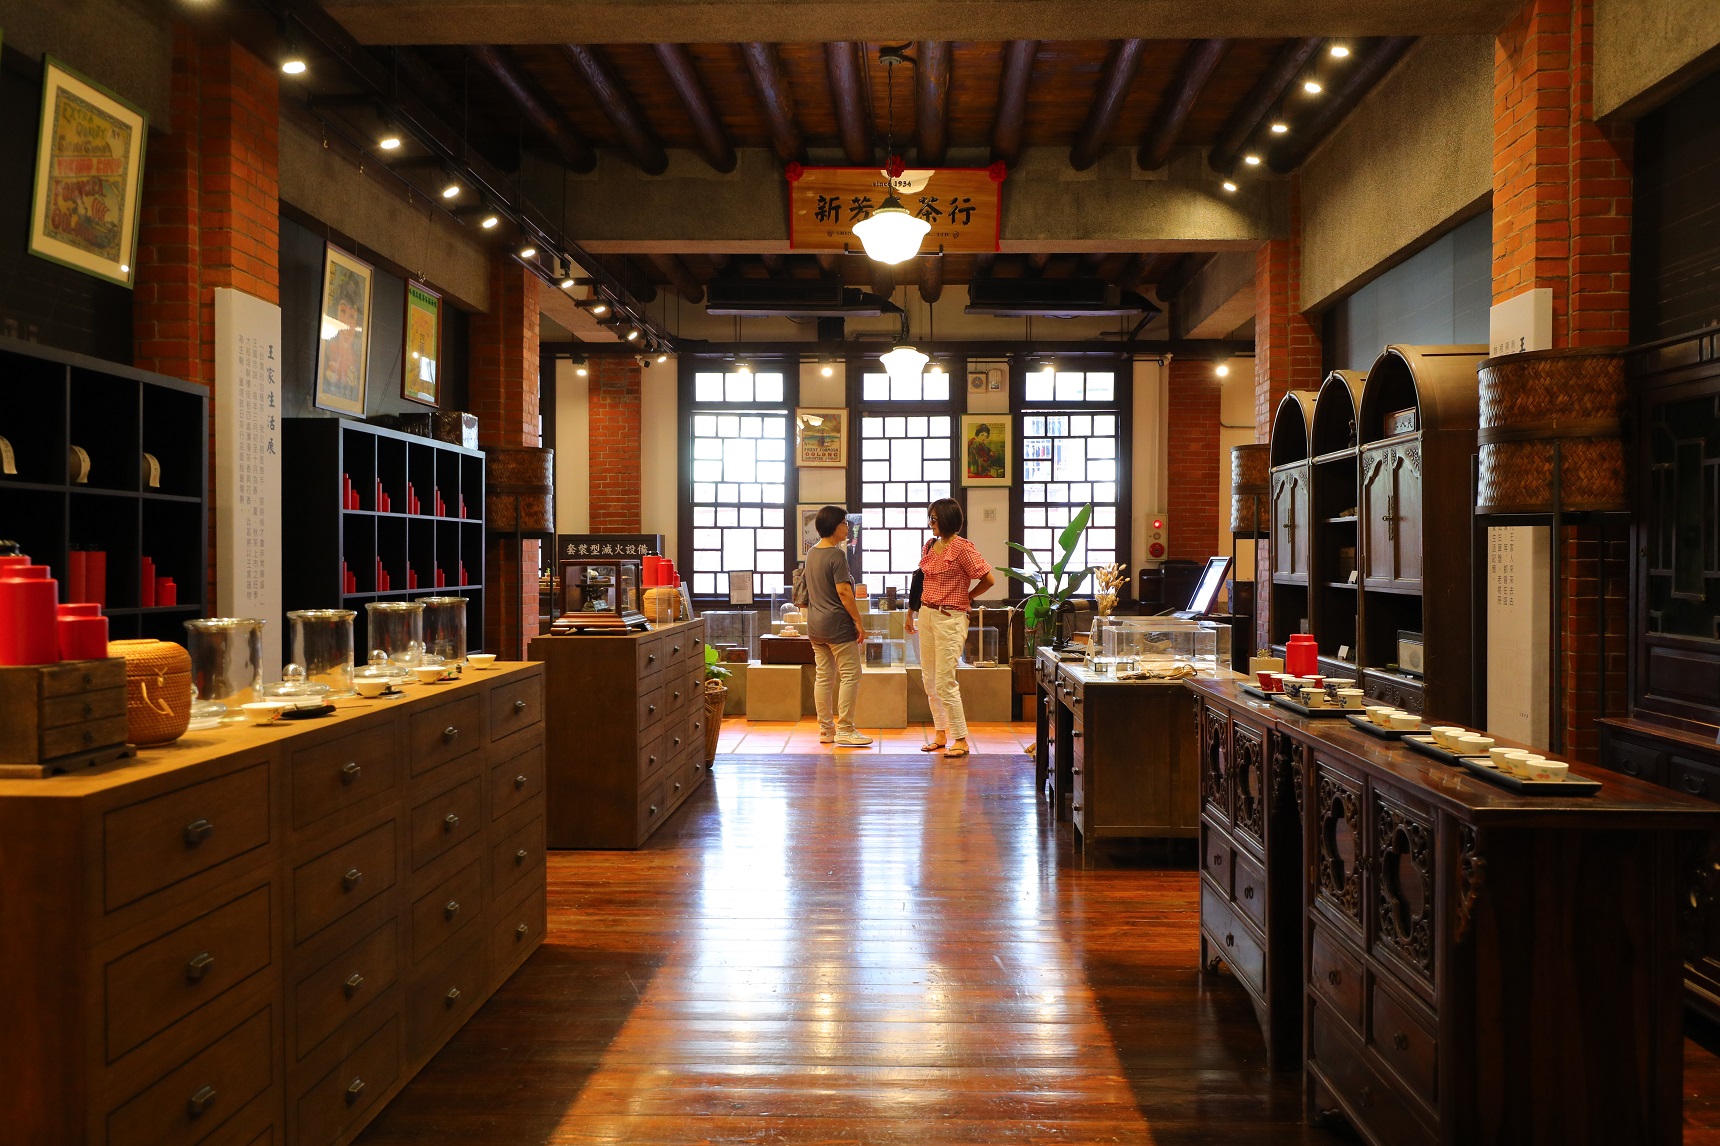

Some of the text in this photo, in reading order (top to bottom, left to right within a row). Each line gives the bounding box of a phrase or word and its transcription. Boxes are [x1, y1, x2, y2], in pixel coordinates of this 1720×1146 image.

[893, 180, 912, 188] 1934
[814, 195, 976, 226] 新芳茶行
[266, 344, 277, 456] 王家生活展
[566, 543, 649, 556] 套裝型滅火設備
